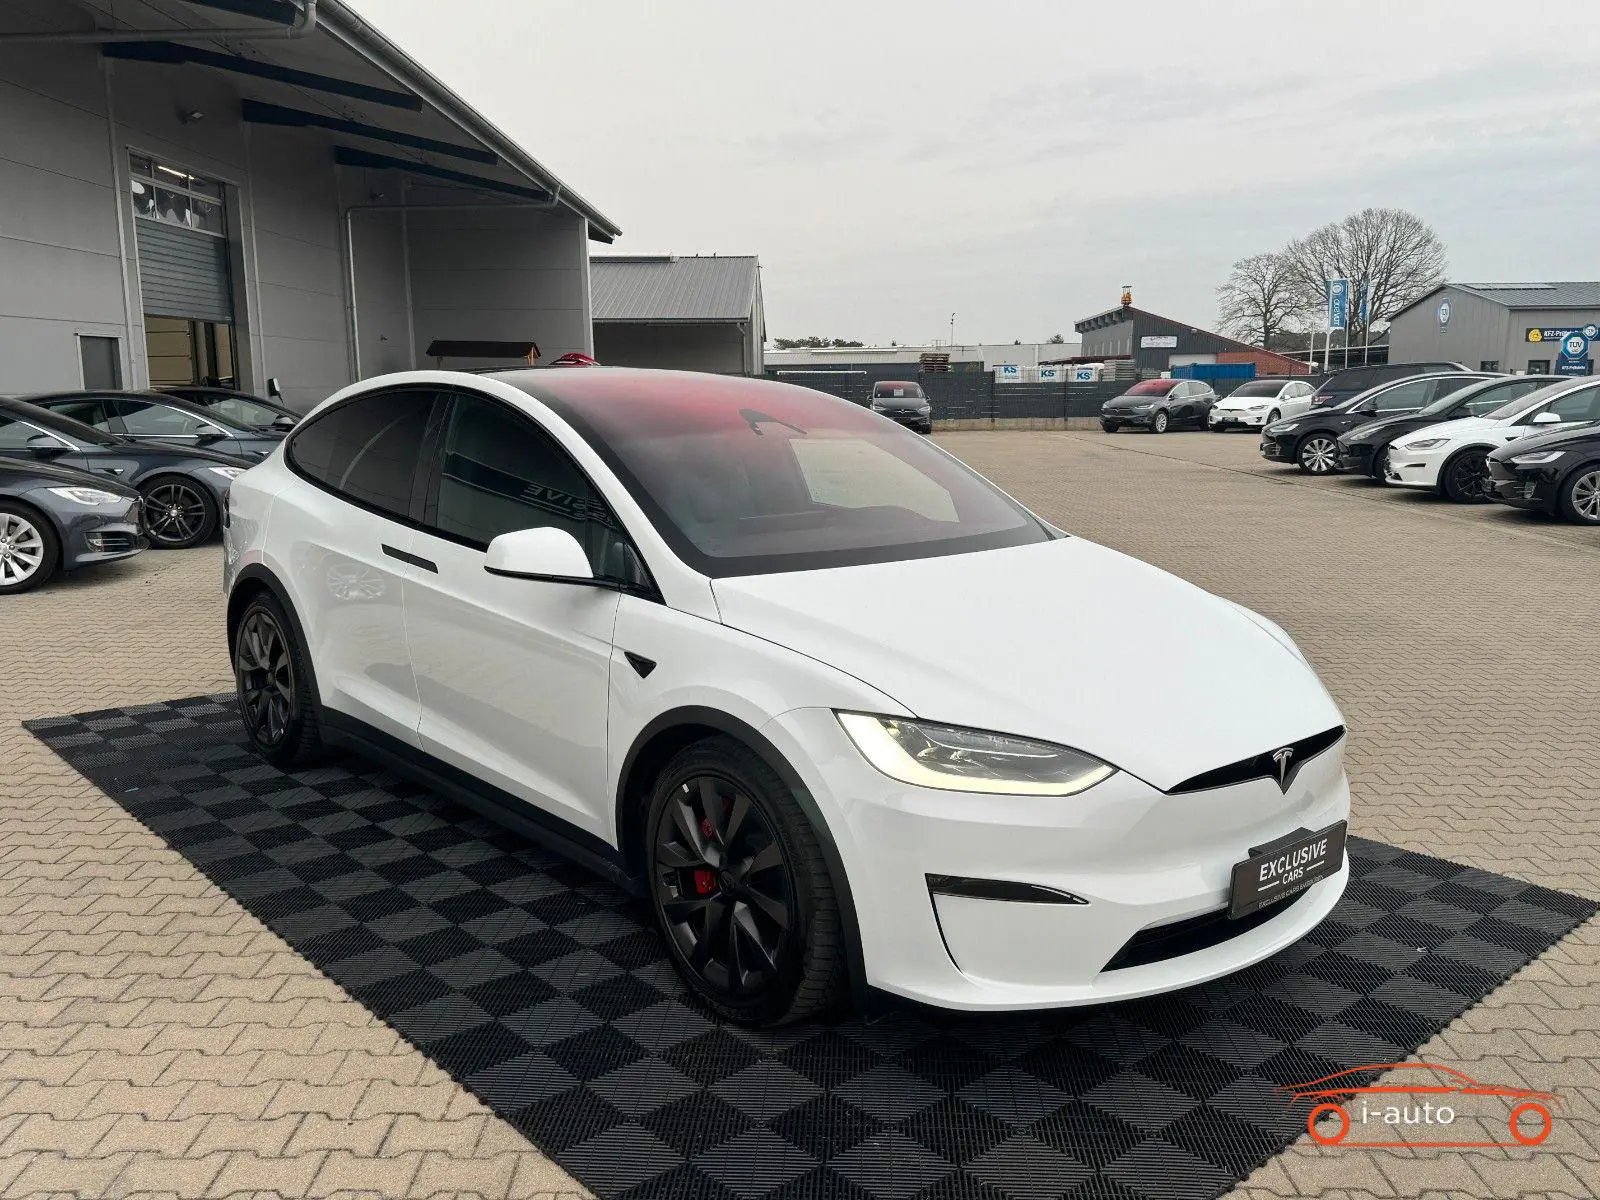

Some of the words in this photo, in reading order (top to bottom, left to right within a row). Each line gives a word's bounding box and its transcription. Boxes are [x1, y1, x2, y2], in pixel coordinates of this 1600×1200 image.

[1003, 366, 1017, 374] KS
[1040, 369, 1055, 378] KS
[1076, 372, 1091, 380] KS
[1259, 838, 1328, 882] EXCLUSIVE
[1282, 866, 1304, 885] CARS
